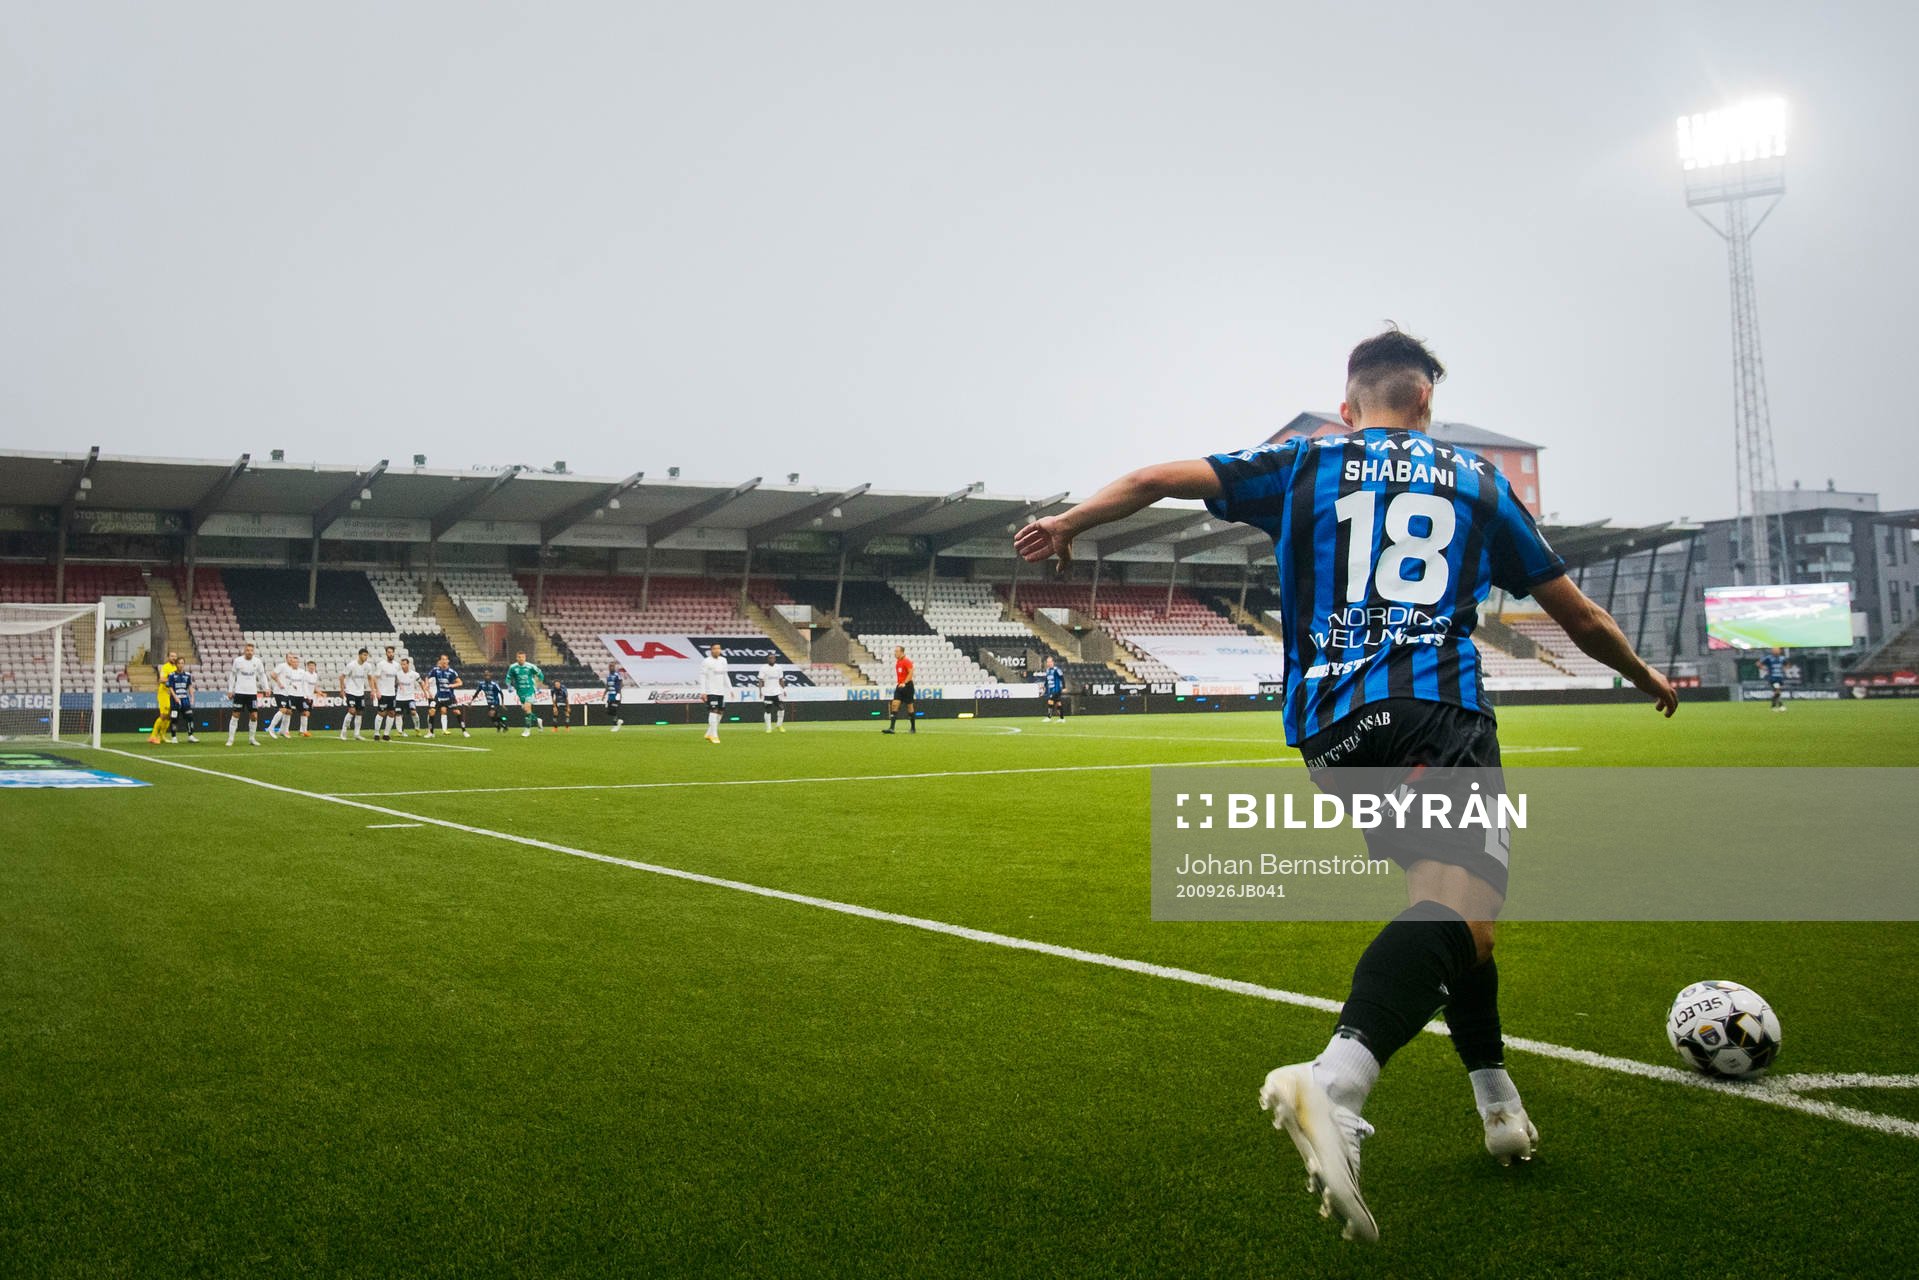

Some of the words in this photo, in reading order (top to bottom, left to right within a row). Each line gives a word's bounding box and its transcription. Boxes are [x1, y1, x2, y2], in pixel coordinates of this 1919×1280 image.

[1344, 459, 1455, 487] SHABANI
[1436, 447, 1485, 475] TAK
[1334, 490, 1456, 606] 18
[1674, 996, 1723, 1028] SELECT
